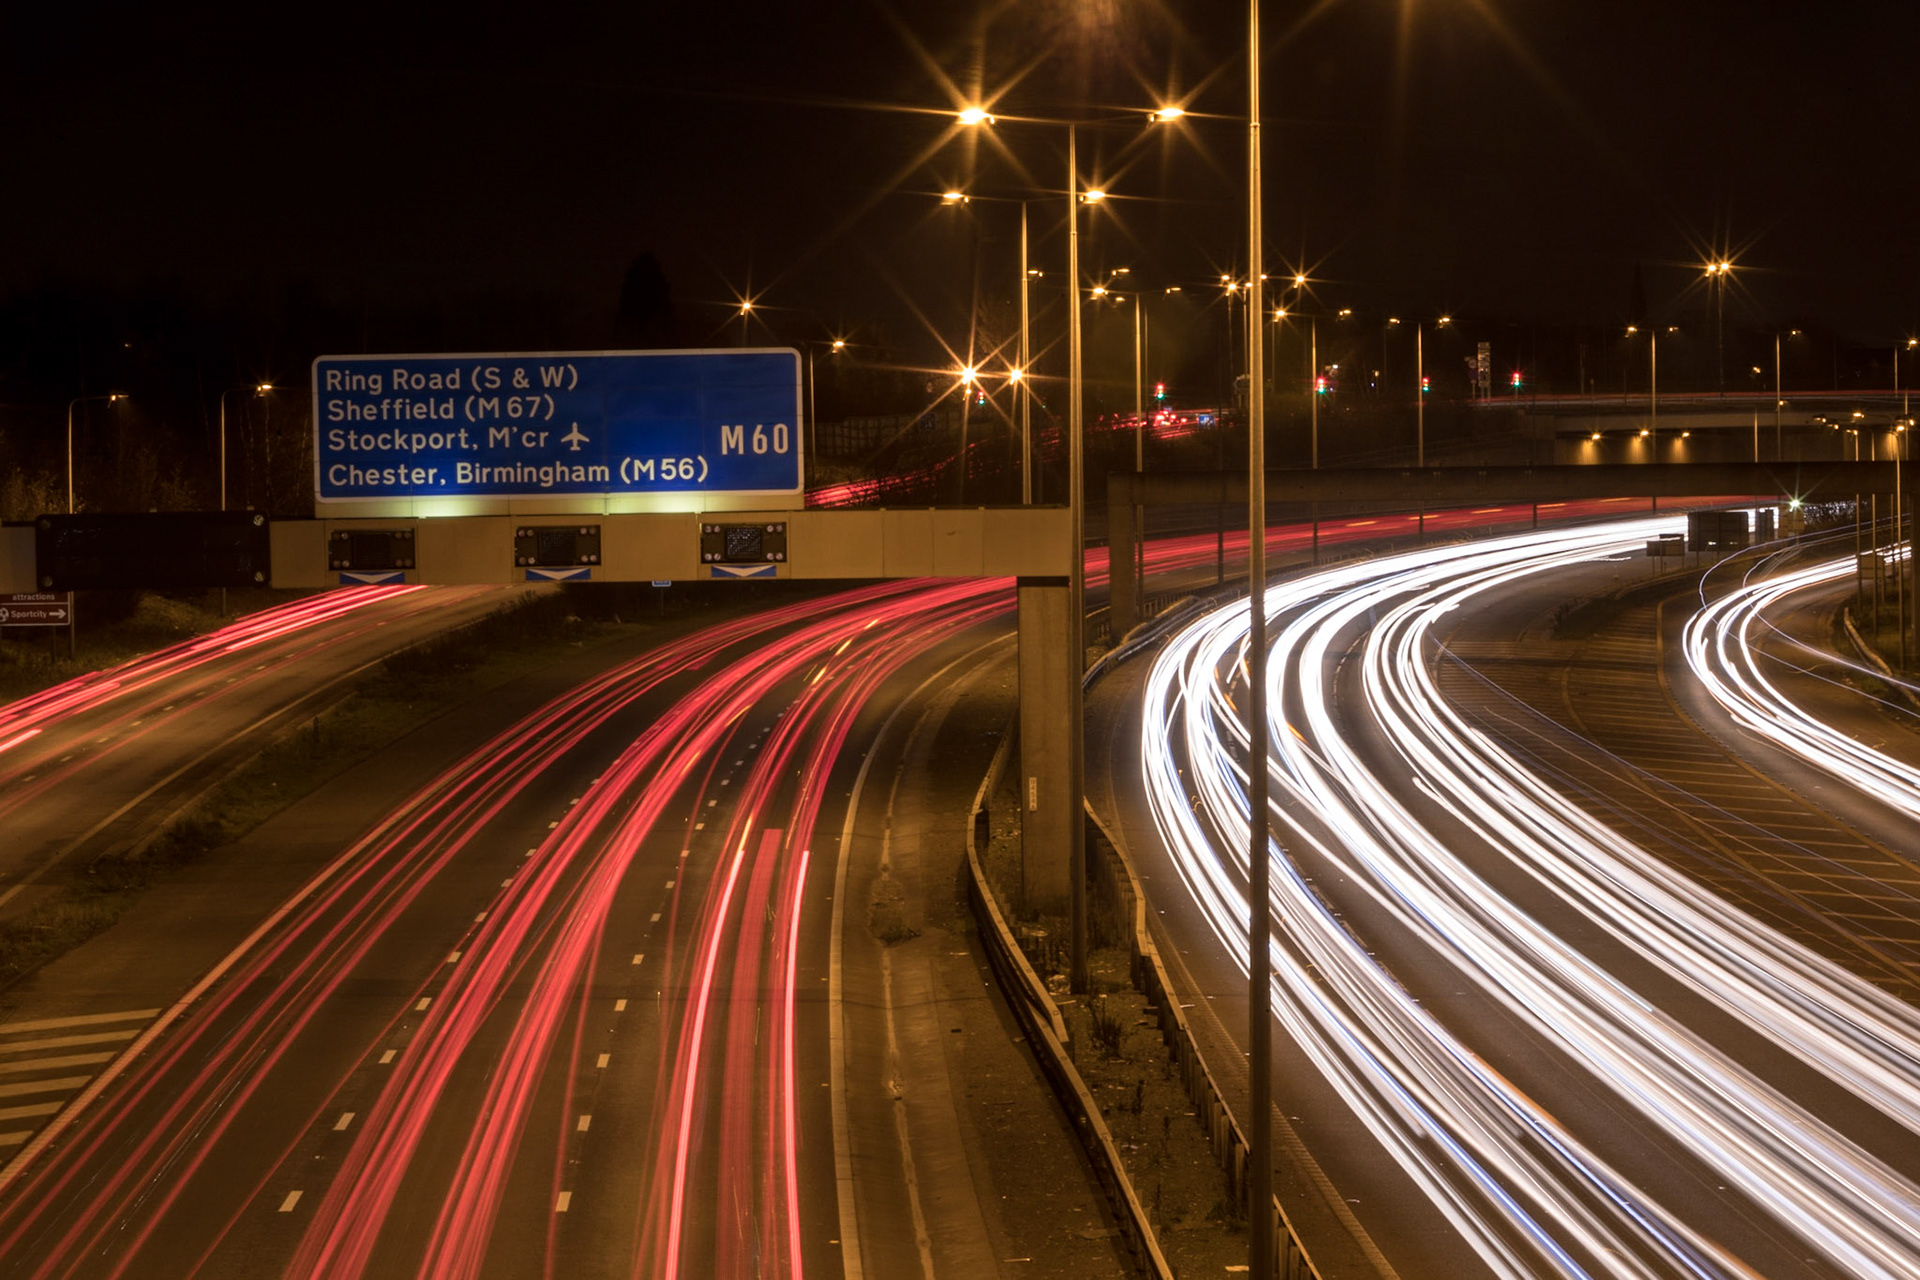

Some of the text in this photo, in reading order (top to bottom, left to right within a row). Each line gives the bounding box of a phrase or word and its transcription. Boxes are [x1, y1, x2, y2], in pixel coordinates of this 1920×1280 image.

[326, 363, 579, 396] Ring Road (S & W)
[327, 397, 455, 422] Sheffield
[328, 428, 479, 454] Stockport,
[328, 463, 447, 487] Chester,
[456, 461, 610, 488] Birmingham
[12, 592, 56, 601] attractions
[11, 610, 47, 619] Sportcity
